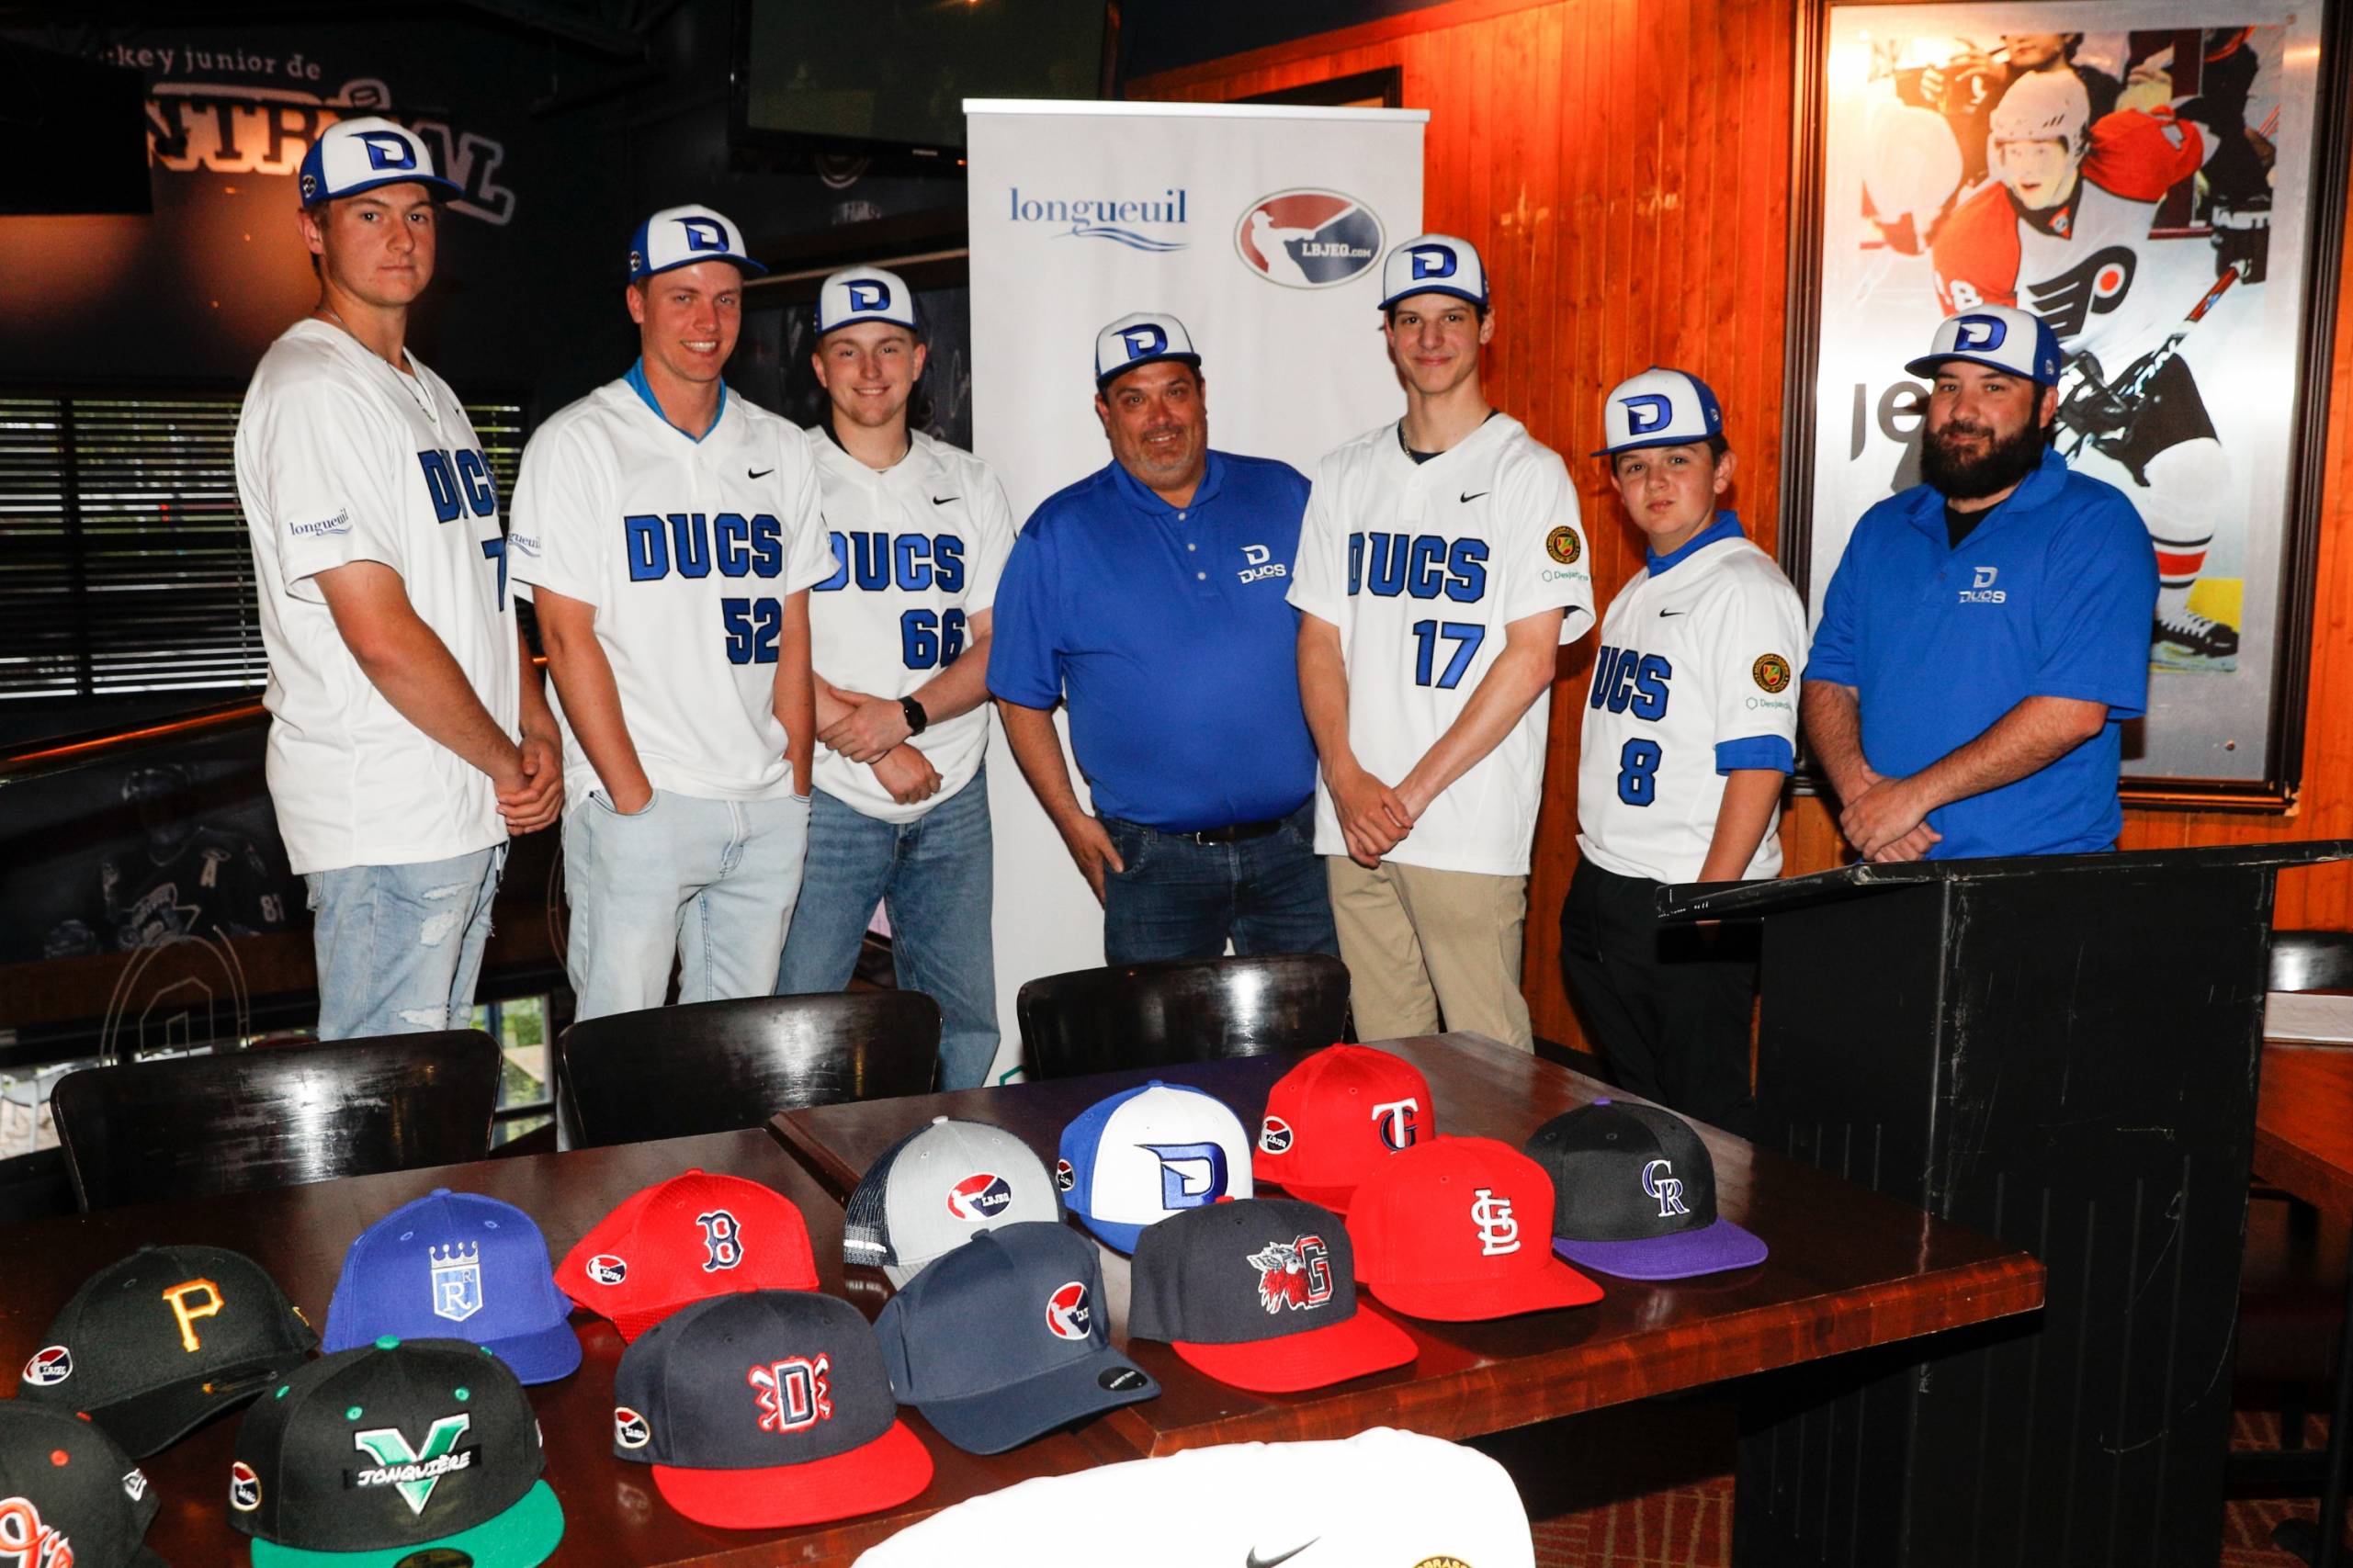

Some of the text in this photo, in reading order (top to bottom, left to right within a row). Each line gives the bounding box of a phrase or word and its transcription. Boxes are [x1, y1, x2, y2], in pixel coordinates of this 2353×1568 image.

[104, 44, 322, 81] key junior de
[346, 130, 417, 170] D
[669, 216, 730, 253] D
[1009, 187, 1188, 233] longueuil
[1403, 243, 1457, 280] D
[837, 278, 891, 312] D
[1111, 323, 1169, 360] D
[1951, 314, 2007, 352] D
[1617, 393, 1672, 435] D
[289, 508, 349, 536] longueuil
[624, 513, 783, 581] DUCS
[1237, 563, 1286, 584] DUCS
[1347, 531, 1490, 604] DUCS
[720, 597, 783, 664] 52
[899, 607, 966, 670] 66
[1412, 619, 1486, 690] 17
[1589, 645, 1672, 722] UCS
[1617, 738, 1662, 807] 8
[1133, 1142, 1228, 1211] D
[1642, 1159, 1691, 1218] CR
[696, 1208, 744, 1274] B
[162, 1278, 225, 1353] P
[773, 1358, 819, 1433] D
